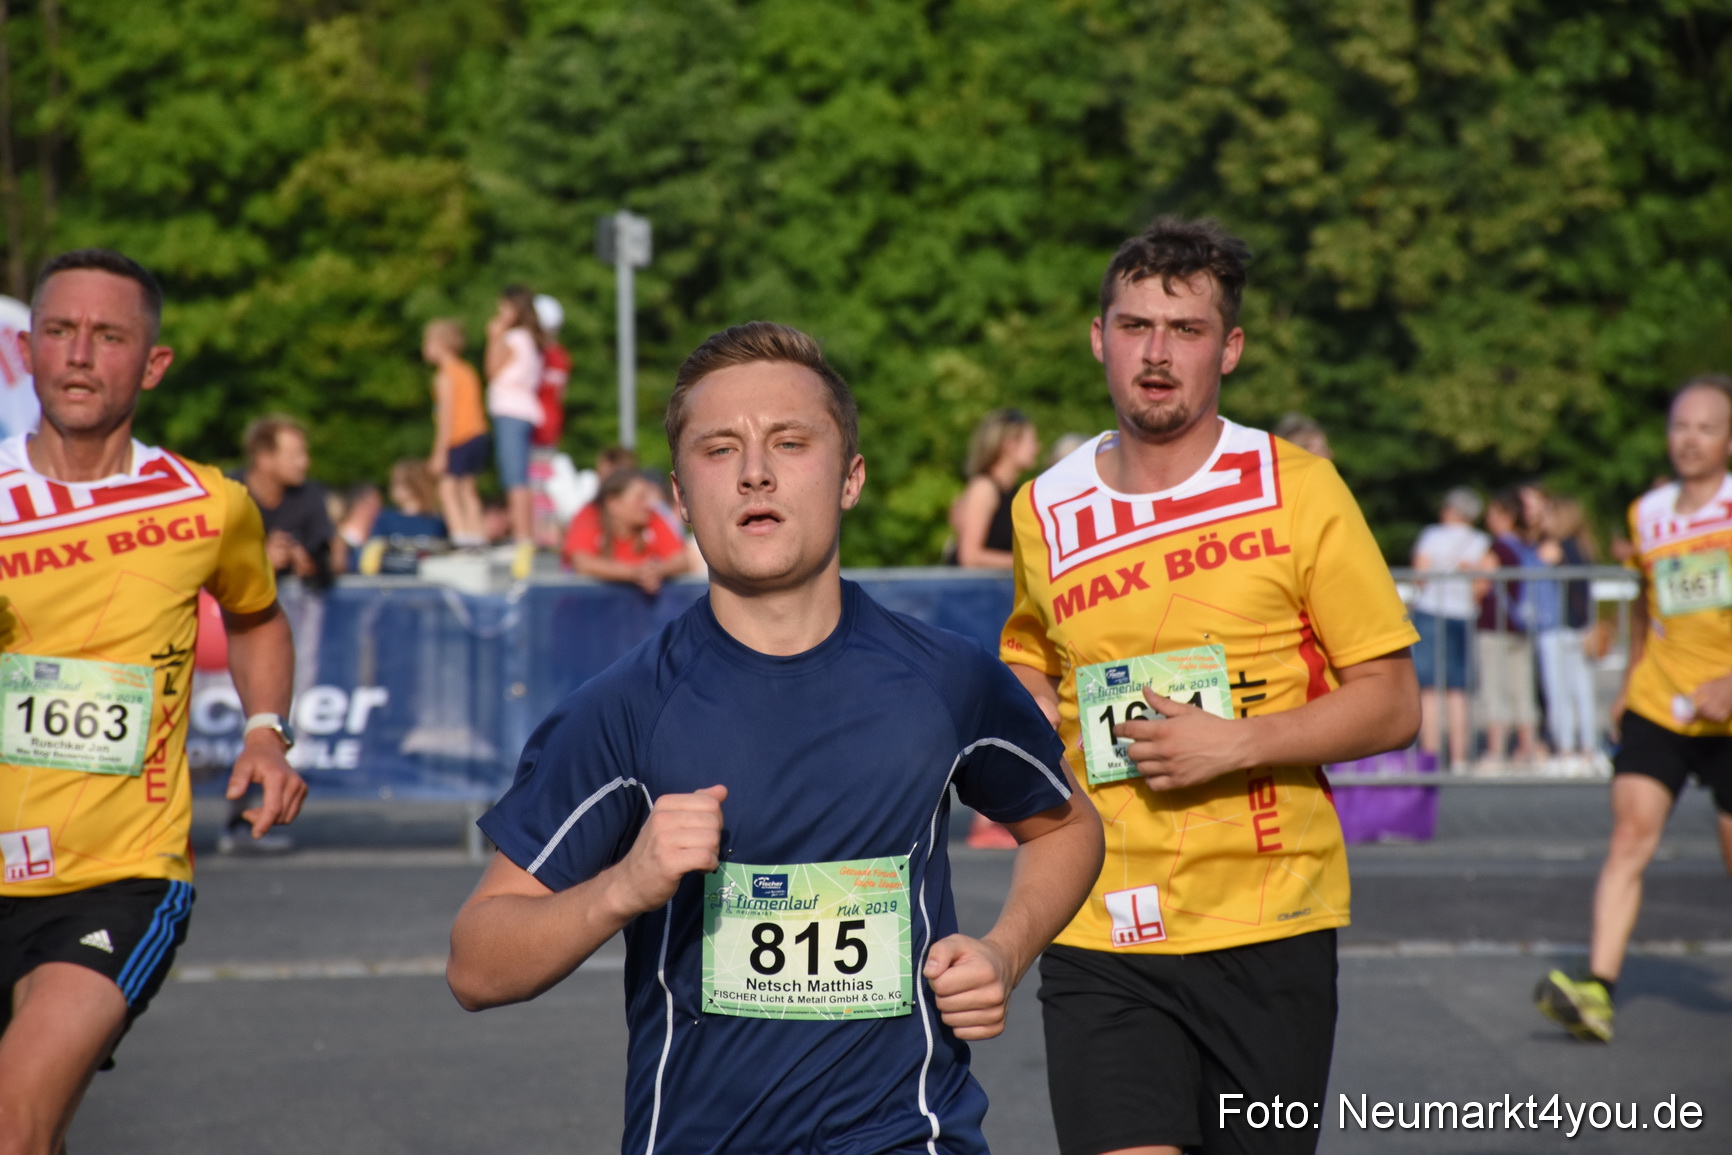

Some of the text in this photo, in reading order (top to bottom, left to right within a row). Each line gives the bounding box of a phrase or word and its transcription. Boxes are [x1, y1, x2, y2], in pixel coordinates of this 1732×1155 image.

[0, 514, 220, 581] MAX BÖGL
[1052, 527, 1291, 626] MAX BÖGL
[1190, 677, 1218, 690] 2019
[17, 696, 129, 742] 1663
[736, 894, 820, 910] firmenlauf
[866, 900, 898, 915] 2019
[750, 919, 868, 976] 815
[746, 977, 873, 993] Netsch Matthias
[713, 989, 902, 1005] FISCHER Licht & Metall GmbH & Co. KG
